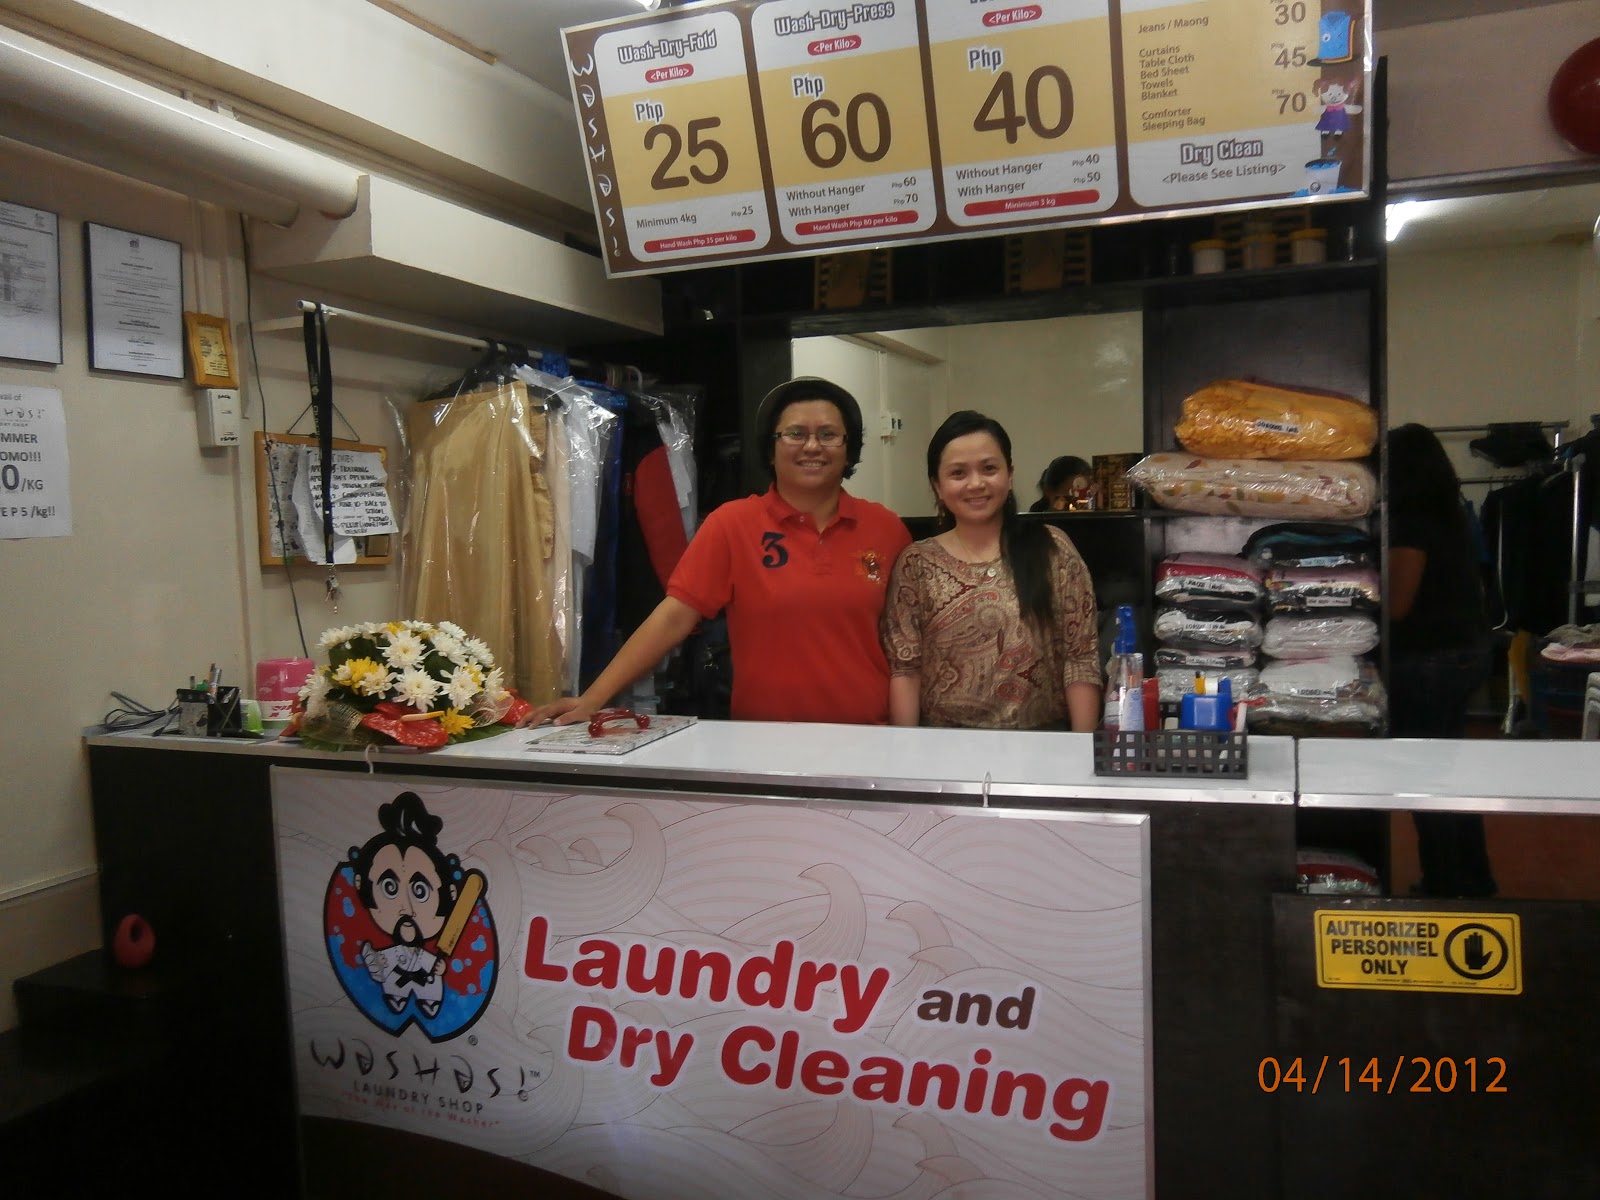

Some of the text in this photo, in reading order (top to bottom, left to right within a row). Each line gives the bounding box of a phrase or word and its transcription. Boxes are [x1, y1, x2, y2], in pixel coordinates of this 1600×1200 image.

[774, 1, 895, 36] Wash-Dry-Press
[1138, 21, 1165, 34] Jeans
[1174, 15, 1209, 28] Maong
[1275, 2, 1306, 26] 30
[618, 28, 717, 64] Wash-Dry-Fold
[1139, 45, 1180, 58] Curtains
[969, 49, 1002, 71] Php
[1139, 53, 1194, 69] Table Cloth
[1274, 45, 1307, 69] 45
[1140, 65, 1189, 79] Bed Sheet
[793, 76, 824, 97] Php
[1141, 78, 1173, 90] Towels
[1141, 88, 1177, 101] Blanket
[635, 102, 664, 122] Php
[973, 65, 1074, 144] 40
[1142, 107, 1191, 120] Comforter
[1276, 91, 1306, 115] 70
[801, 92, 892, 169] 60
[1142, 116, 1206, 131] Sleeping Bag
[643, 116, 729, 190] 25
[1180, 138, 1263, 166] Dry Clean
[955, 168, 1000, 180] Without
[1002, 162, 1043, 175] Hanger
[1086, 154, 1100, 164] 40
[1162, 163, 1286, 184] <Please See Listing>
[786, 188, 826, 201] Without
[828, 183, 866, 196] Hanger
[903, 176, 917, 187] 60
[957, 186, 983, 197] With
[985, 181, 1026, 194] Hanger
[1086, 171, 1101, 182] 50
[788, 205, 811, 217] With
[814, 203, 850, 215] Hanger
[905, 193, 919, 203] 70
[1005, 200, 1039, 210] Minimum
[1046, 198, 1056, 206] kg
[636, 216, 678, 229] Minimum
[680, 213, 697, 225] 4kg
[741, 205, 754, 216] 25
[813, 222, 831, 232] Hand
[831, 220, 849, 230] Wash
[849, 219, 862, 229] Php
[873, 217, 884, 227] per
[885, 215, 898, 224] kilo
[660, 240, 677, 249] Hand
[677, 237, 692, 247] Wash
[693, 236, 705, 246] Php
[714, 236, 725, 245] per
[725, 234, 738, 242] kilo
[0, 433, 38, 444] MMER
[0, 451, 41, 462] OMO!!!
[11, 506, 18, 517] P
[21, 506, 28, 517] 5
[761, 531, 789, 569] 3
[1326, 920, 1439, 938] AUTHORIZED
[1331, 939, 1438, 957] PERSONNEL
[523, 916, 1036, 1034] Laundry and
[1361, 959, 1408, 975] ONLY
[567, 1006, 1110, 1143] Dry Cleaning
[354, 1080, 483, 1114] LAUNDRY SHOP
